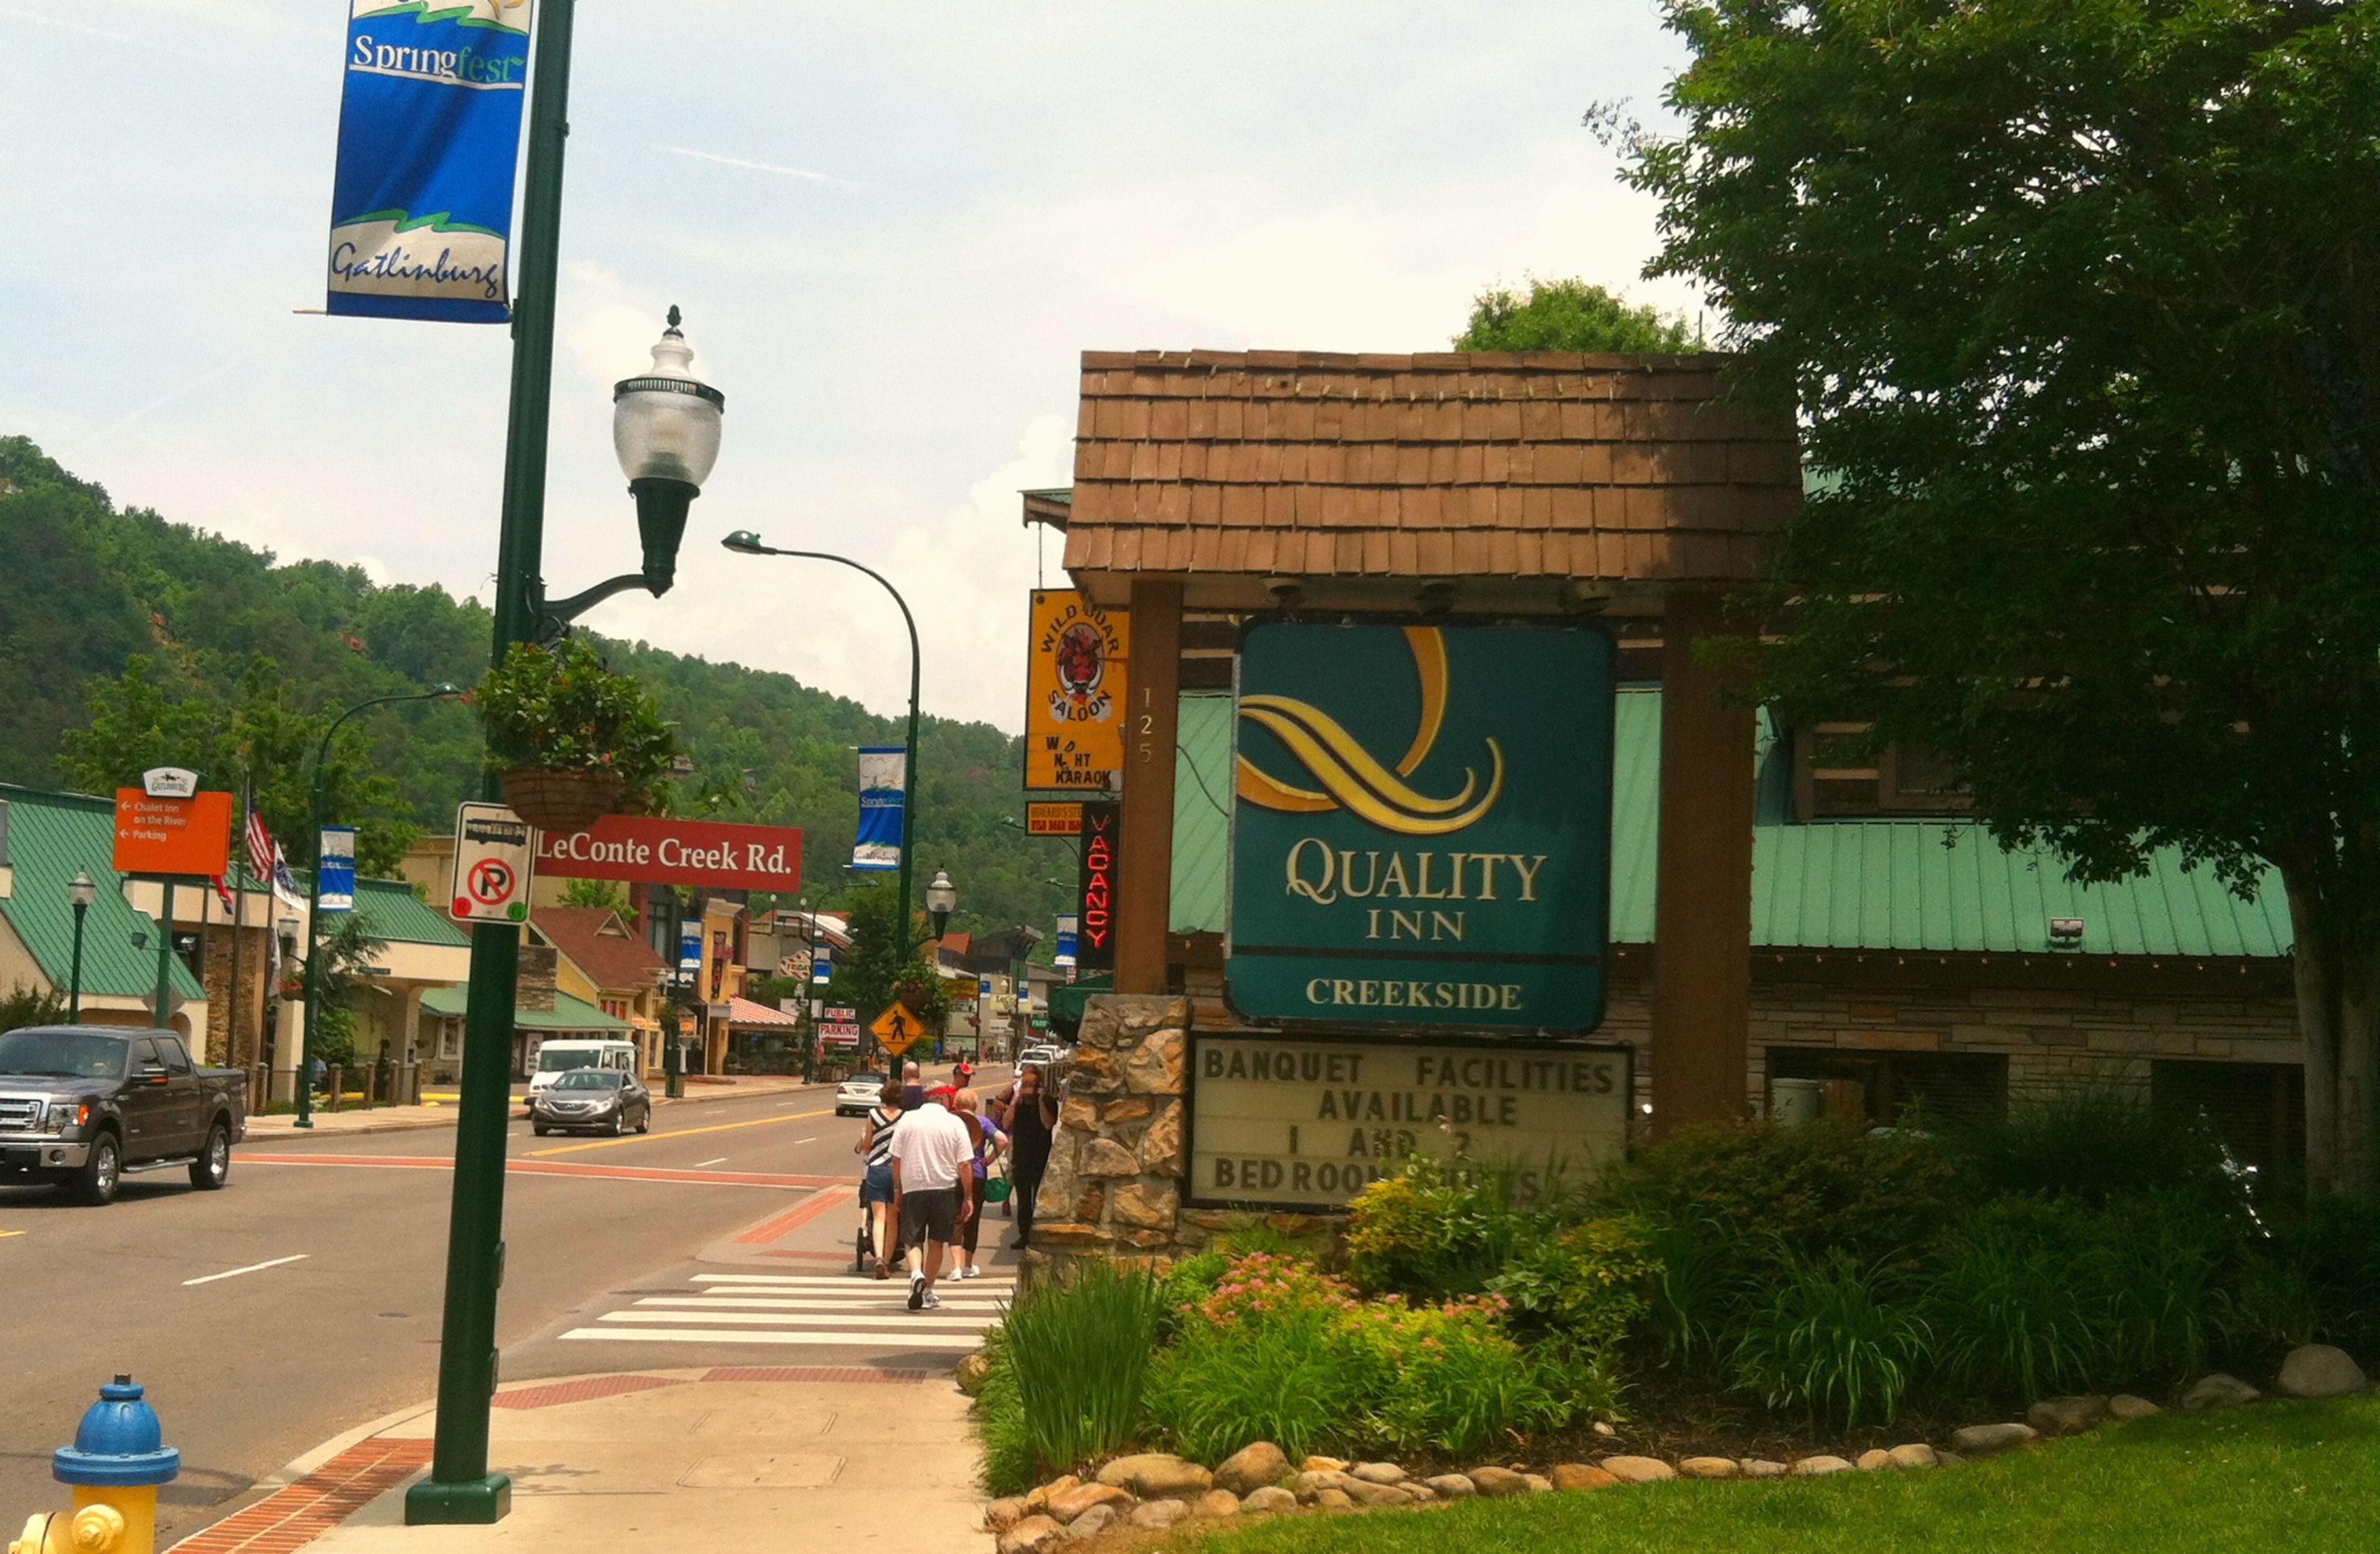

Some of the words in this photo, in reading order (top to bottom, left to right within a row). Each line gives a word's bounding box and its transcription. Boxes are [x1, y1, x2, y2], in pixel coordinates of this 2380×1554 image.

[332, 242, 498, 298] Gatlinburg
[1041, 604, 1077, 653] WILD
[1047, 689, 1113, 722] SALOON
[148, 816, 164, 825] the
[164, 816, 187, 826] River
[165, 805, 179, 813] Inn
[133, 830, 167, 842] Parking
[536, 832, 651, 865] LeConte
[658, 837, 739, 870] Creek
[745, 844, 792, 874] Rd.
[1085, 814, 1111, 948] VACANCY
[1285, 837, 1548, 904] QUALITY
[1365, 909, 1466, 942] INN
[1305, 978, 1522, 1011] CREEKSIDE
[826, 1009, 853, 1018] PUBLIC
[820, 1025, 858, 1036] PARKING
[1204, 1048, 1364, 1085] BANQUET
[1417, 1056, 1613, 1094] FACILITIES
[1318, 1090, 1518, 1126] AVAILABLE
[1347, 1128, 1417, 1159] AND
